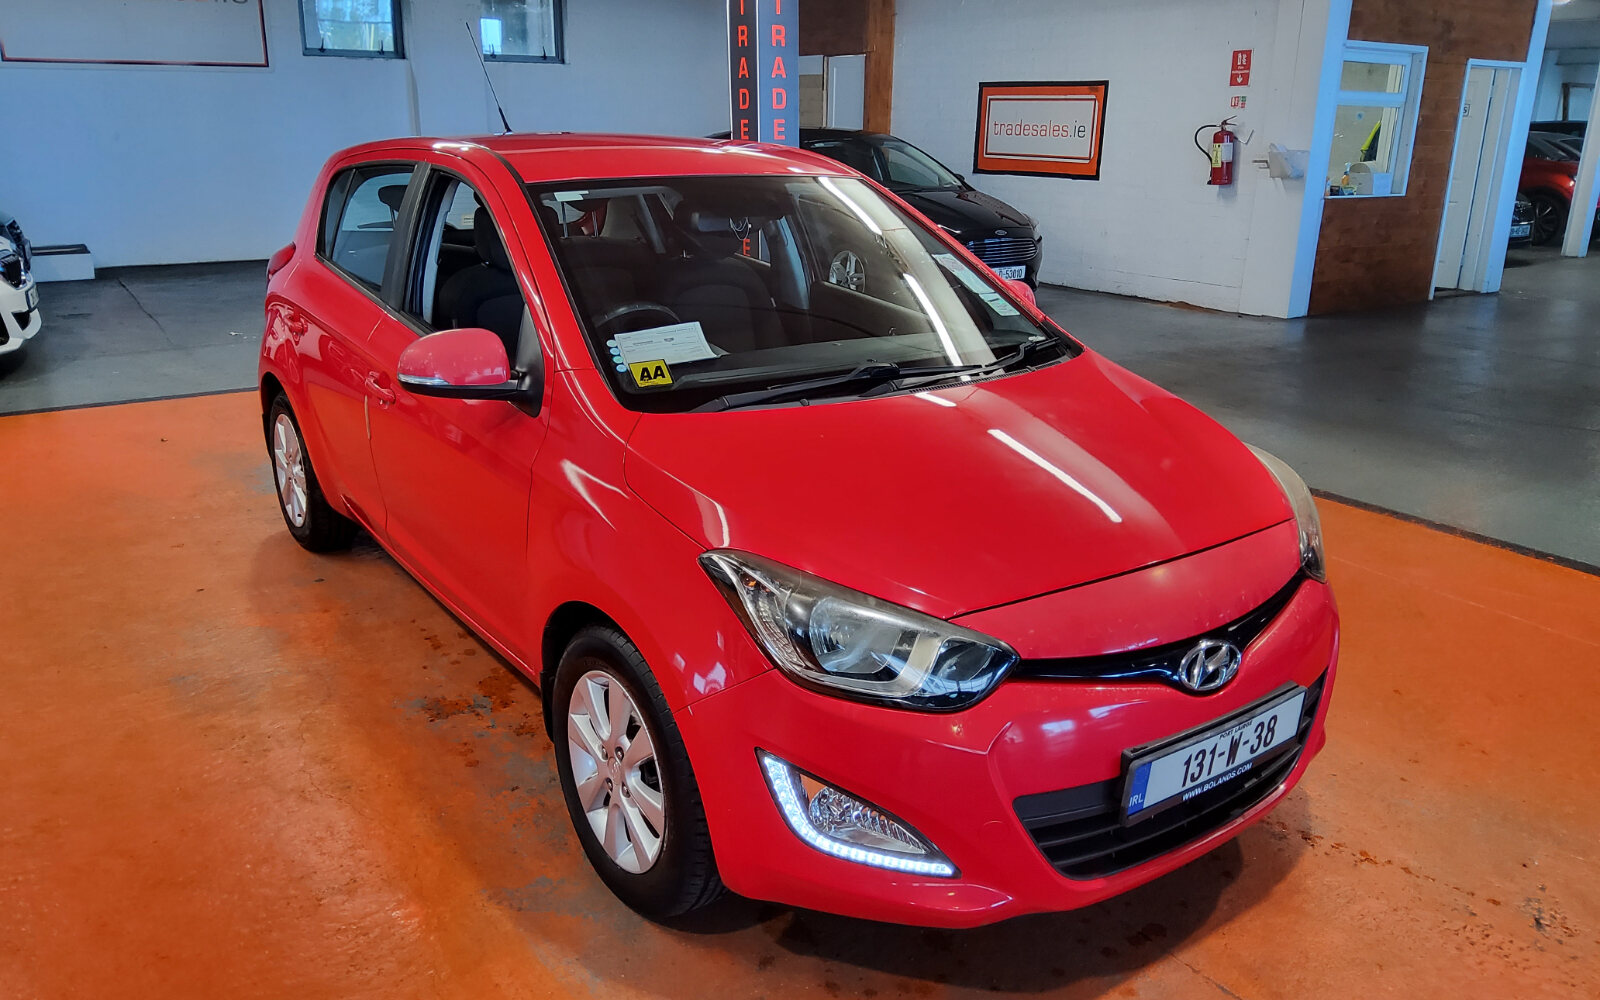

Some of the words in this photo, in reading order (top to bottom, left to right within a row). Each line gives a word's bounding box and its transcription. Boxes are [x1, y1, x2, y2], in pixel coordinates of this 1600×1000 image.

[993, 119, 1086, 138] tradesales.ie
[640, 365, 666, 381] AA
[1181, 714, 1279, 788] 131-W-38
[1182, 762, 1254, 801] WWW.BOLANDS.COM
[1128, 792, 1144, 807] IRL
